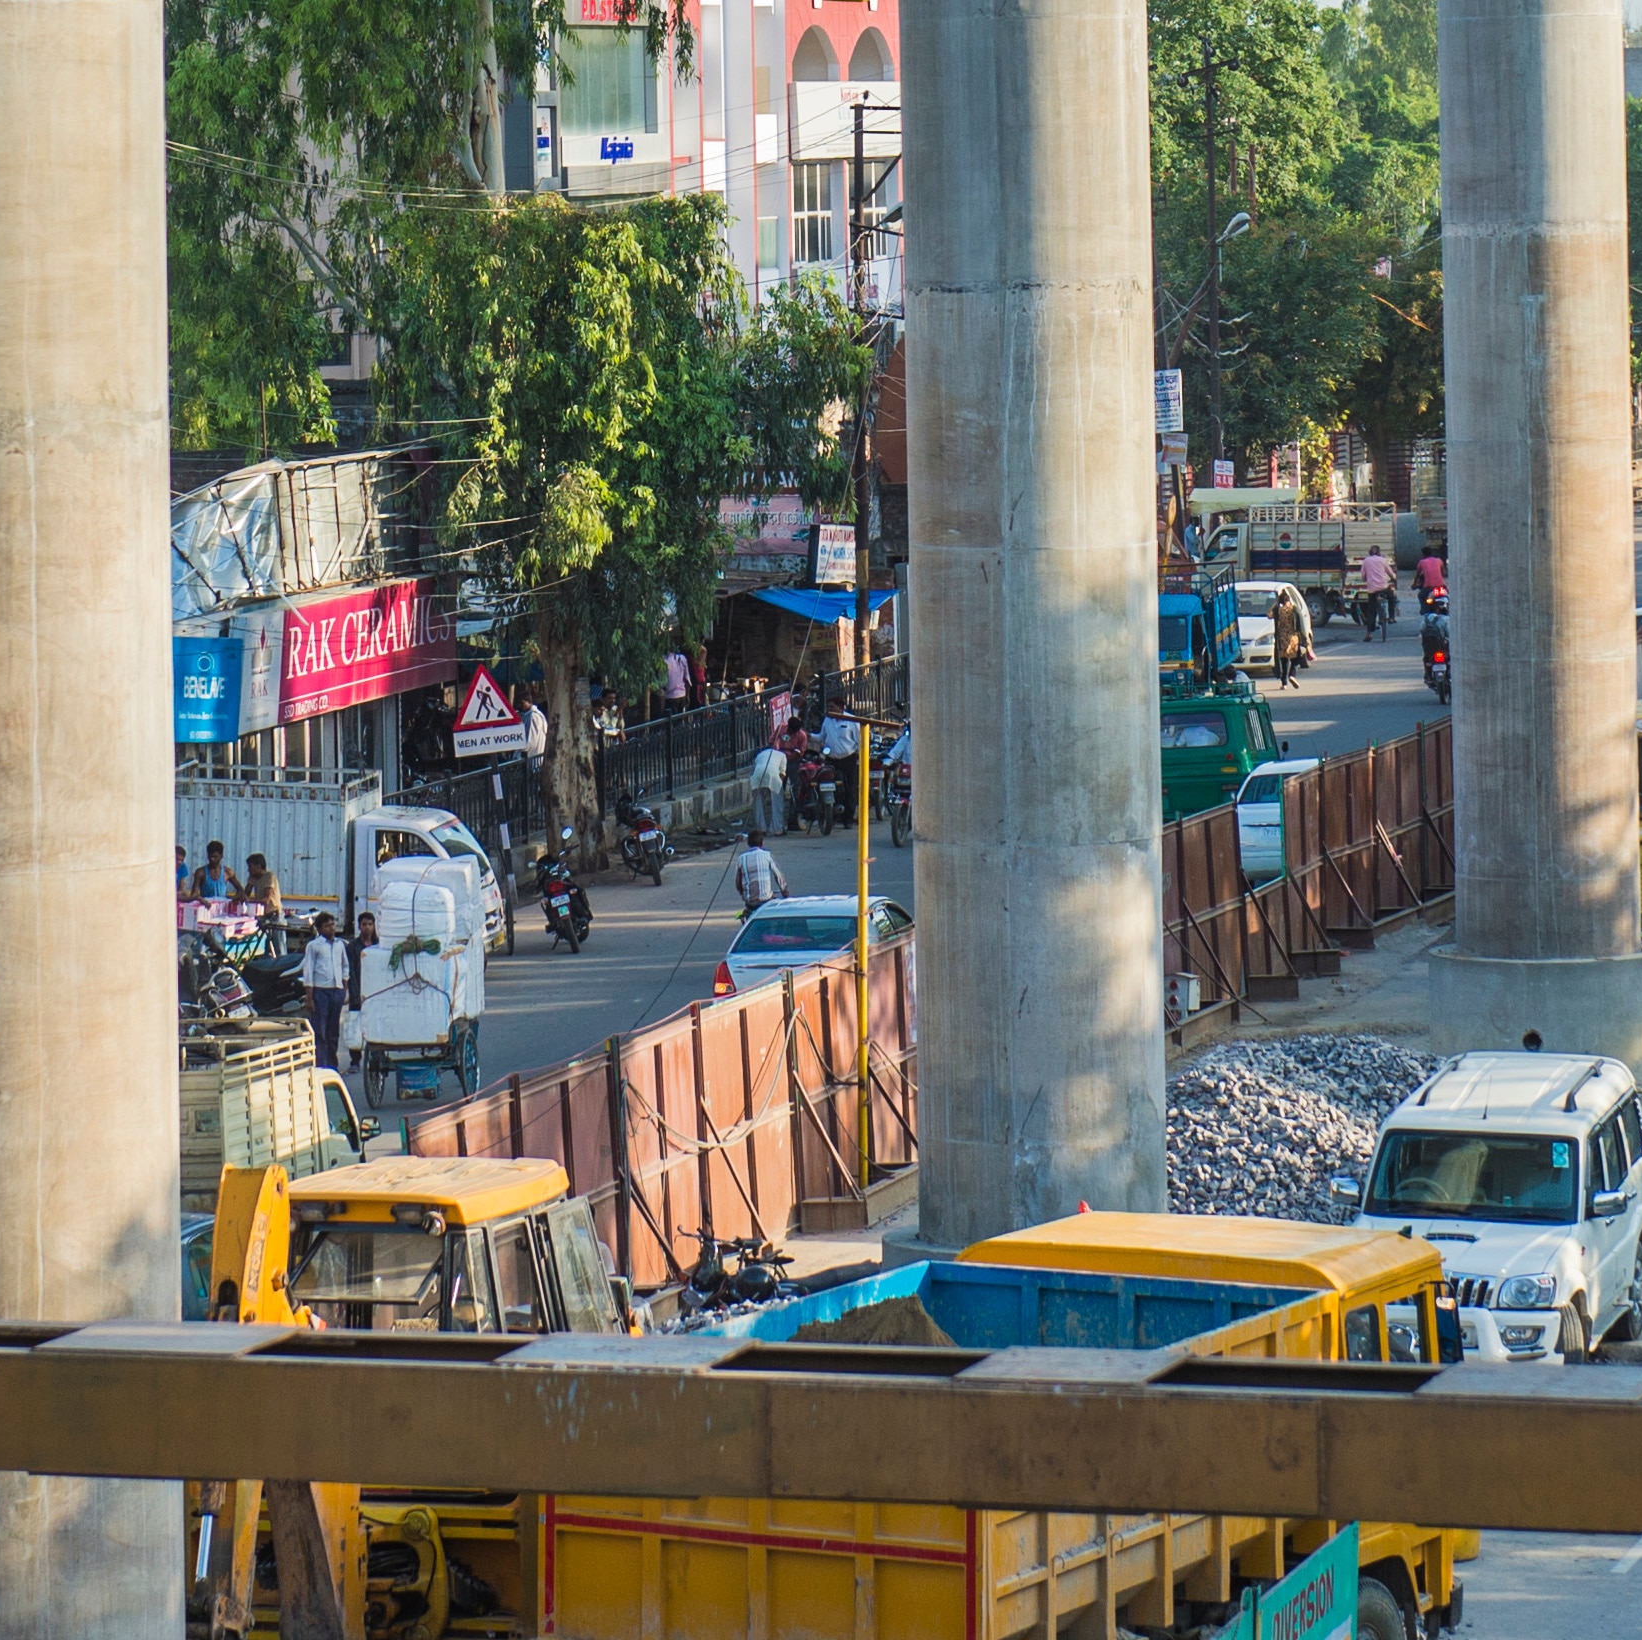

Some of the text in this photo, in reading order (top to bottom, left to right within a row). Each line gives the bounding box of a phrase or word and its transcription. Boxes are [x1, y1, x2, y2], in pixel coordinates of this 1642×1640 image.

[286, 593, 452, 681] RAK CERAMICS
[250, 679, 269, 700] RAK
[457, 732, 524, 748] MEN AT WORK
[1272, 1562, 1335, 1640] DIVERSION
